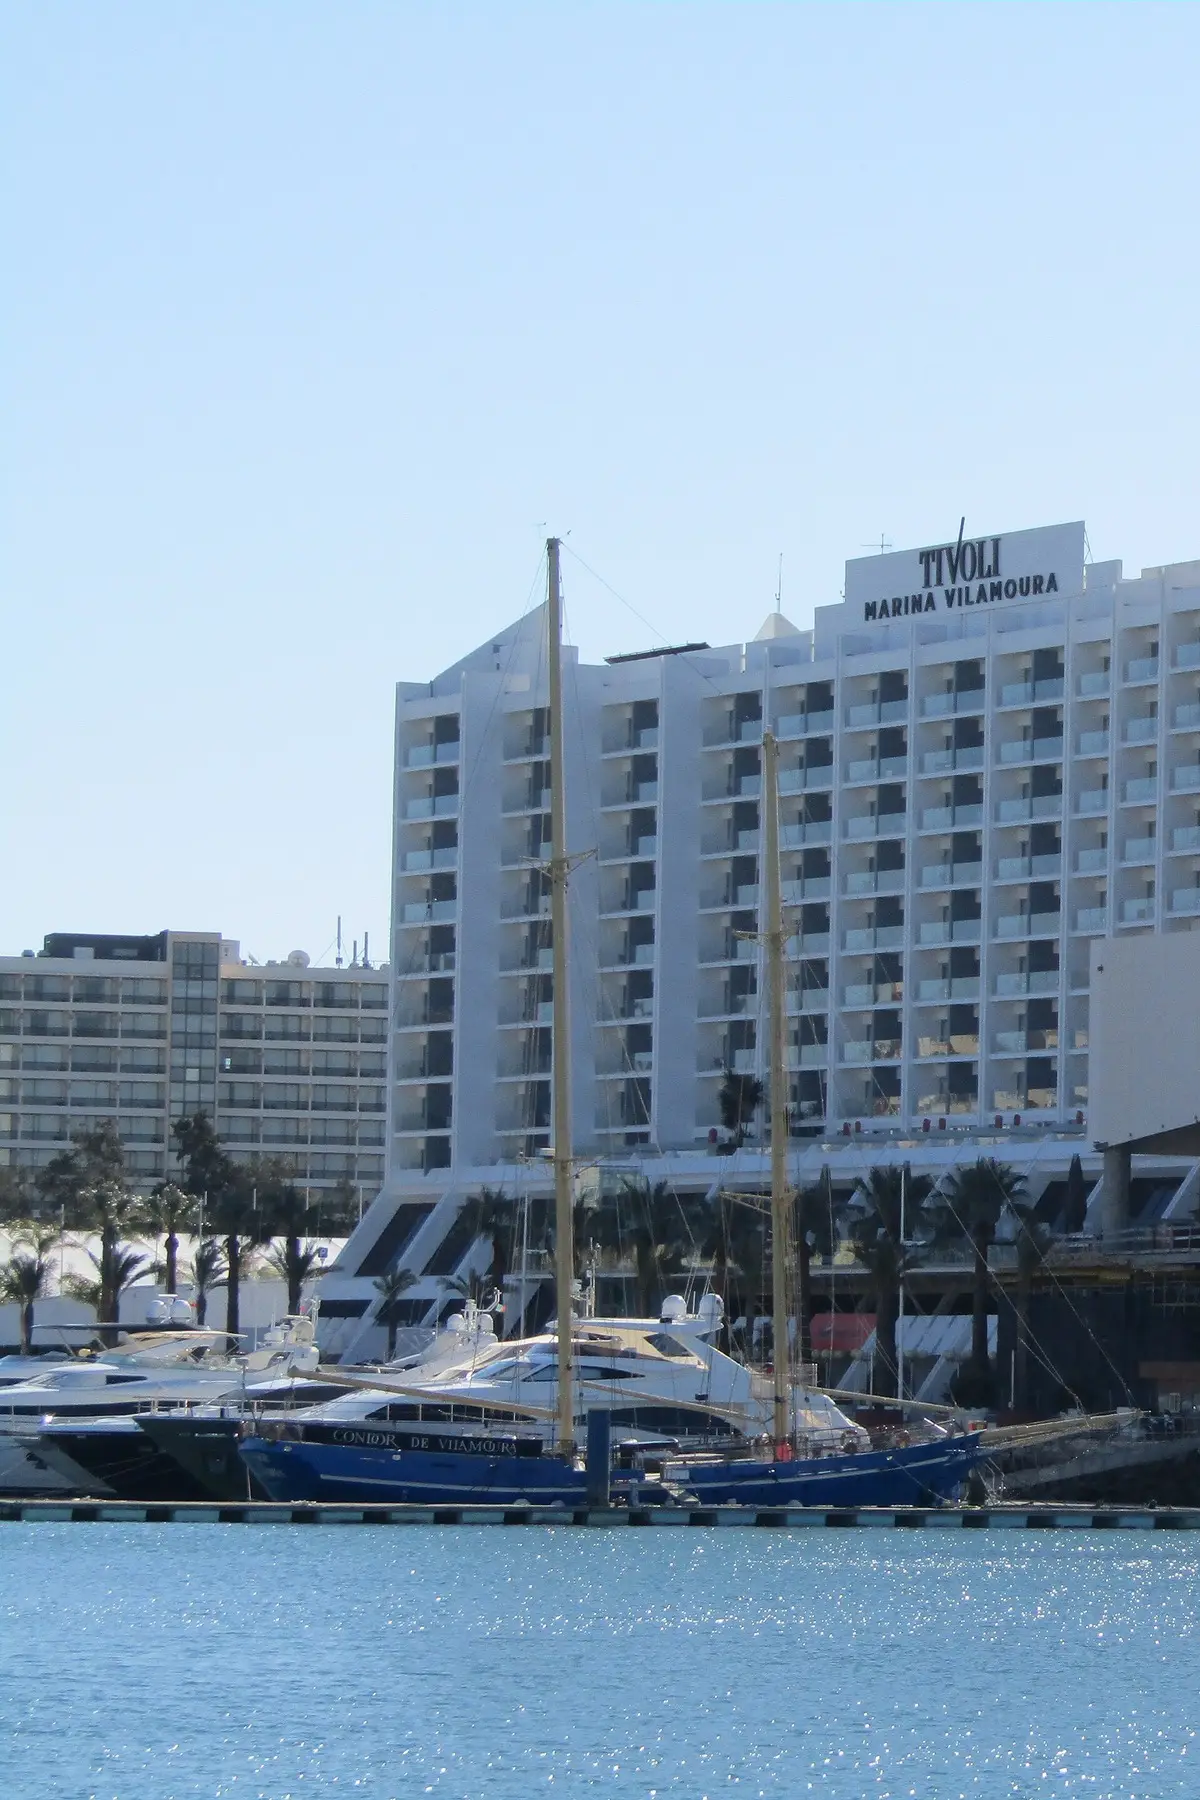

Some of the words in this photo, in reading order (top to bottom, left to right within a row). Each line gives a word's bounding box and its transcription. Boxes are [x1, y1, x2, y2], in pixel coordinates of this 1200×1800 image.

[919, 516, 1002, 589] TIVOLI
[864, 591, 936, 622] MARINA
[944, 572, 1059, 609] VILAMOURA
[333, 1429, 400, 1449] CONDOR
[411, 1436, 429, 1449] DE
